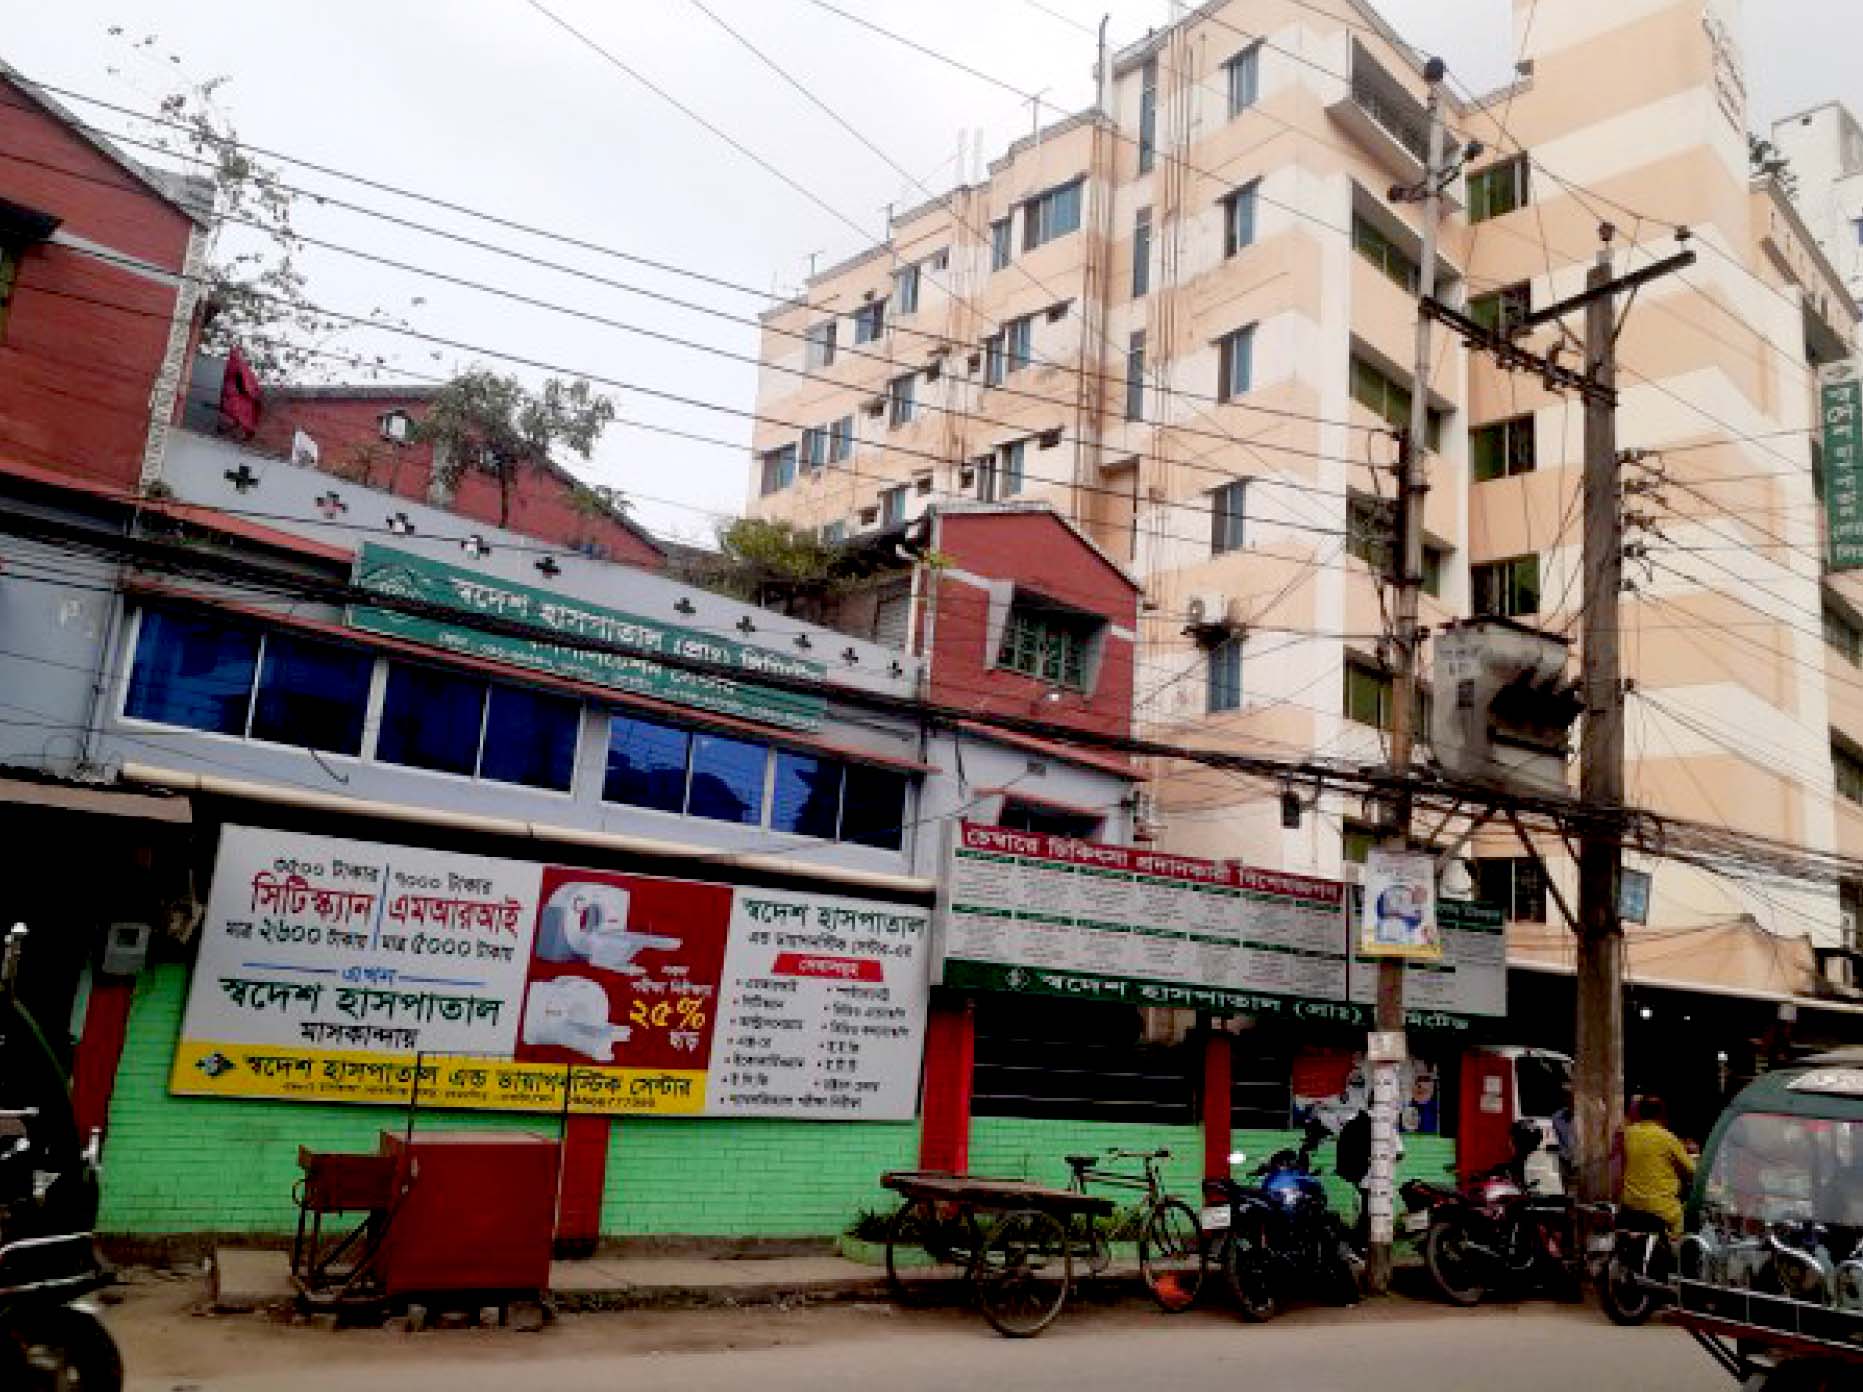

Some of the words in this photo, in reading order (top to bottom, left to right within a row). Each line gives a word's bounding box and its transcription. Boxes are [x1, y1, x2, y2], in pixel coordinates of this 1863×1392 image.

[450, 577, 529, 617] স্বদেশ
[539, 602, 662, 648] হাসপাতাল
[250, 870, 376, 924] সিটিস্ক্যান
[388, 894, 524, 939] এমআরআই
[258, 917, 321, 946] ২৬০০
[741, 897, 809, 928] স্বদেশ
[816, 905, 928, 940] হাসপাতাল
[410, 930, 471, 958] ৫০০০
[217, 977, 324, 1014] স্বদেশ
[335, 986, 506, 1028] হাসপাতাল
[1041, 974, 1128, 997] স্বদেশ
[1142, 983, 1282, 1012] হাসপাতাল
[299, 1021, 420, 1049] মাসকান্দায়
[244, 1056, 315, 1083] স্বদেশ
[321, 1058, 440, 1086] হাসপাতাল
[629, 1071, 694, 1097] সেন্টার
